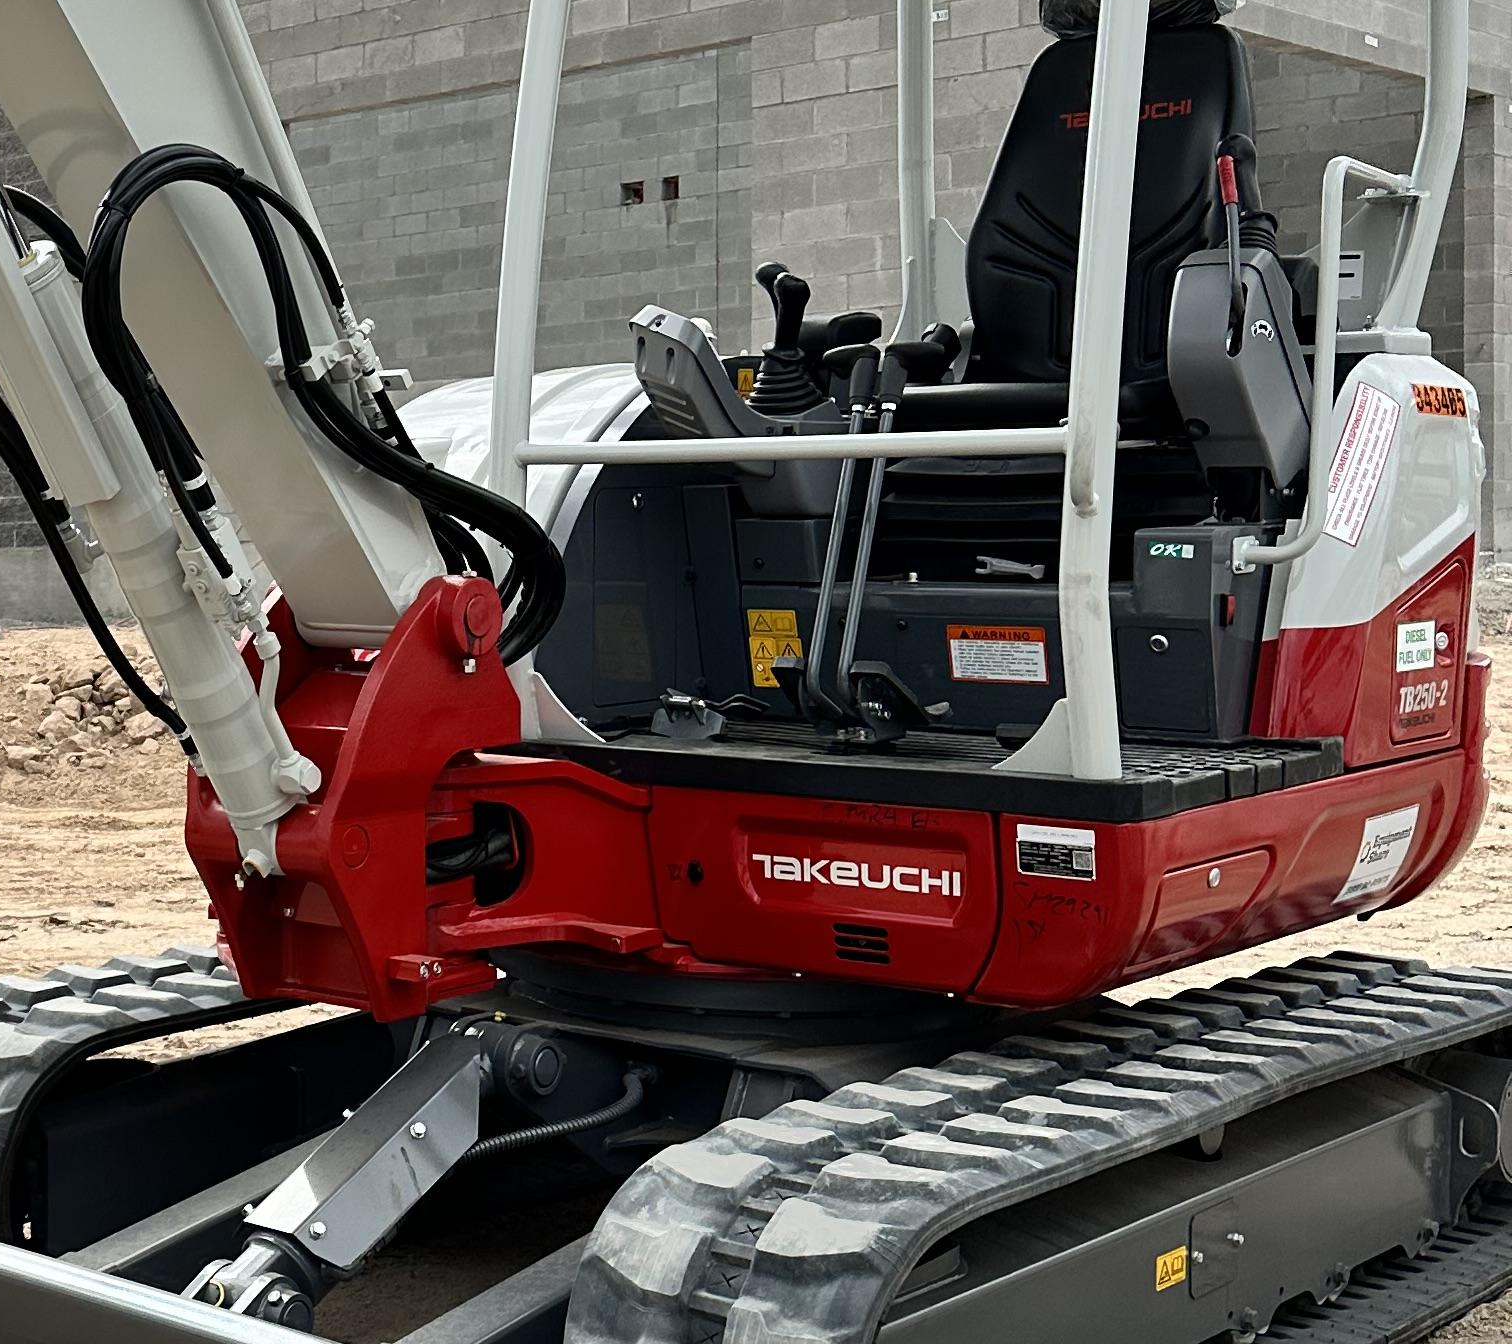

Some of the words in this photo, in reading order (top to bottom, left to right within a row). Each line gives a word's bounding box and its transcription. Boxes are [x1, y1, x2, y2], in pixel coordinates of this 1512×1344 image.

[1150, 543, 1182, 557] OK
[971, 630, 1031, 641] WARNING
[1405, 629, 1427, 644] DIESEL
[1399, 651, 1415, 665] FUEL
[1416, 648, 1432, 662] ONLY
[1399, 679, 1448, 714] TB250-2
